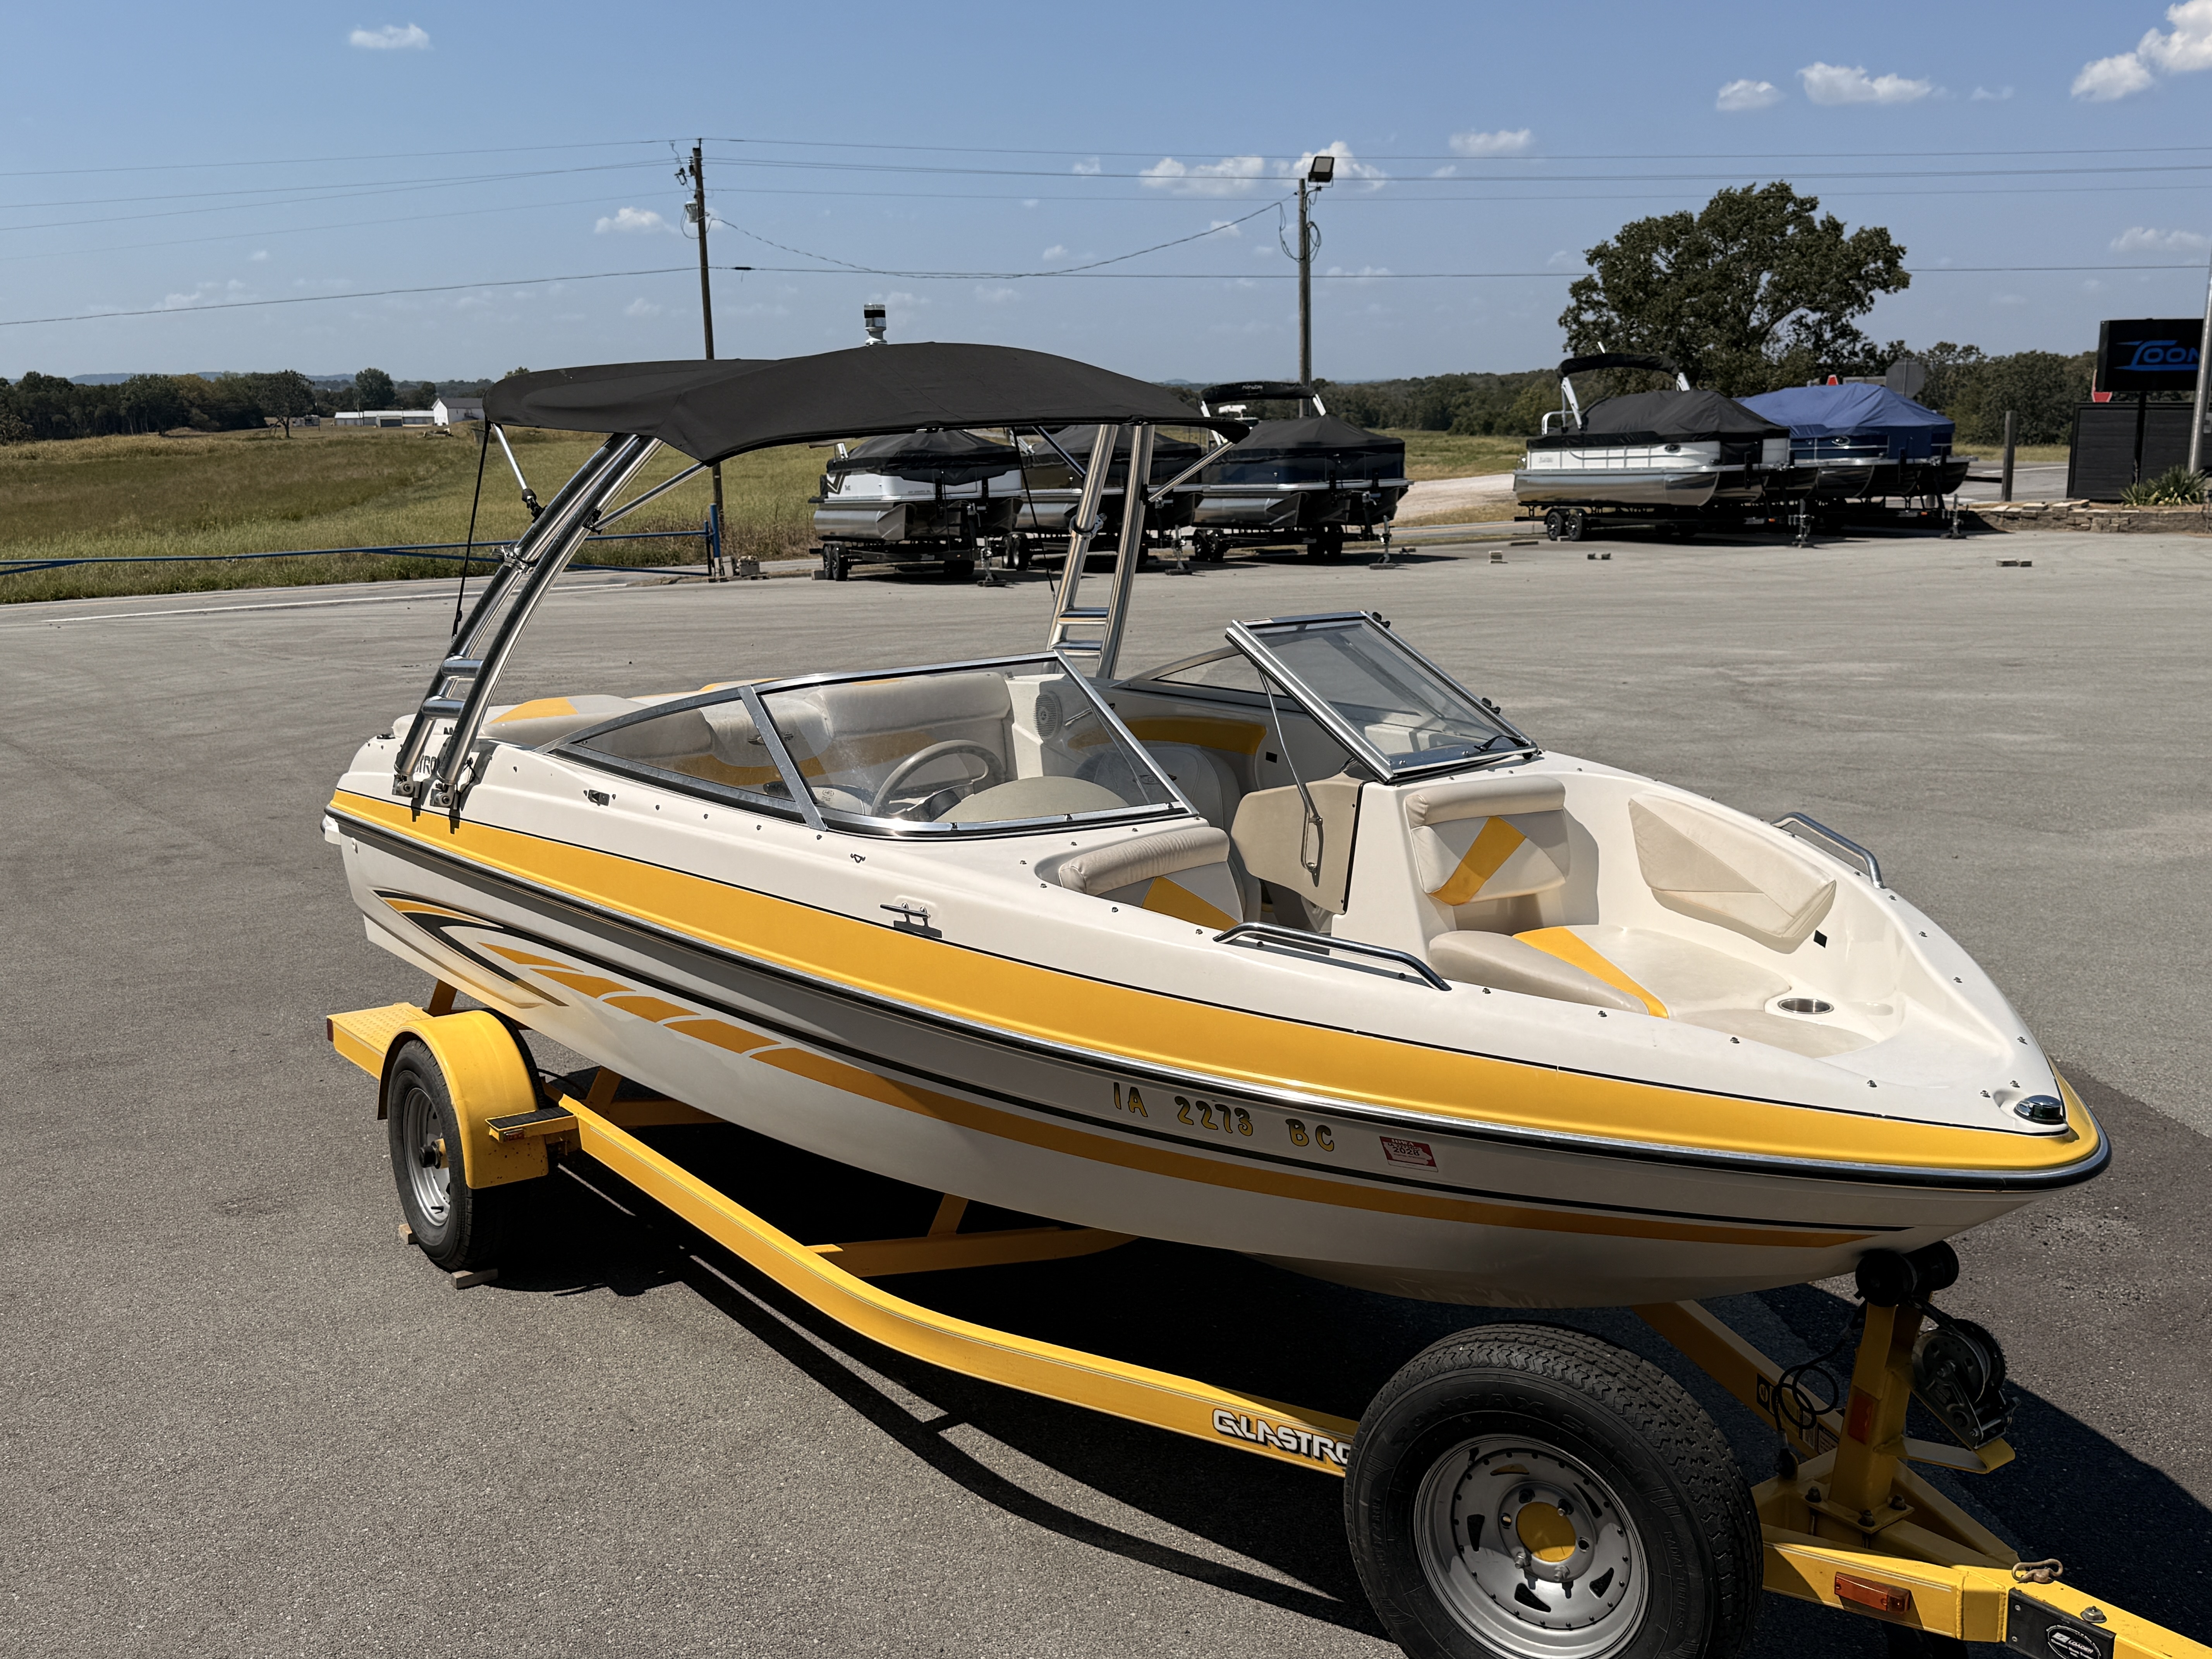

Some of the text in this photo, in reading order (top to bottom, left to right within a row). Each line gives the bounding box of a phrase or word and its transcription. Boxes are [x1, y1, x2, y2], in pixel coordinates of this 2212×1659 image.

[1113, 1082, 1334, 1152] IA 2273 BC
[1393, 1146, 1420, 1156] 2028
